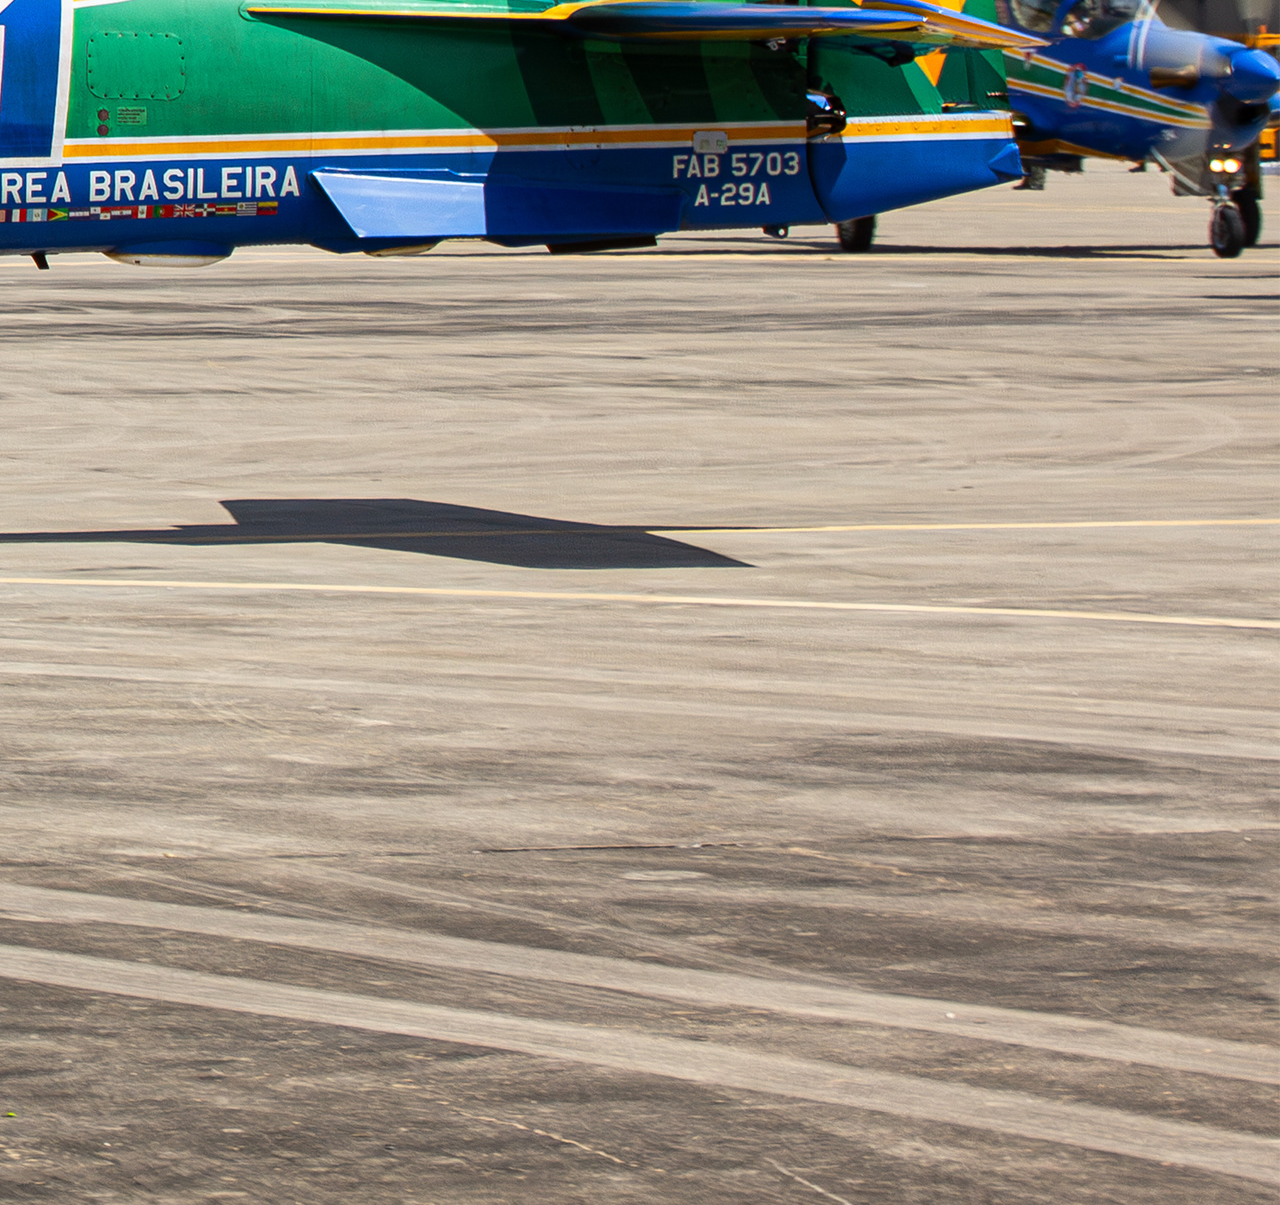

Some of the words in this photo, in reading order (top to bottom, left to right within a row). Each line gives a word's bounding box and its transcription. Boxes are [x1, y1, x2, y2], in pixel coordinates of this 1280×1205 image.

[672, 154, 720, 179] FAB
[731, 152, 800, 177] 5703
[89, 165, 300, 202] BRASILEIRA
[694, 182, 771, 207] A-29A
